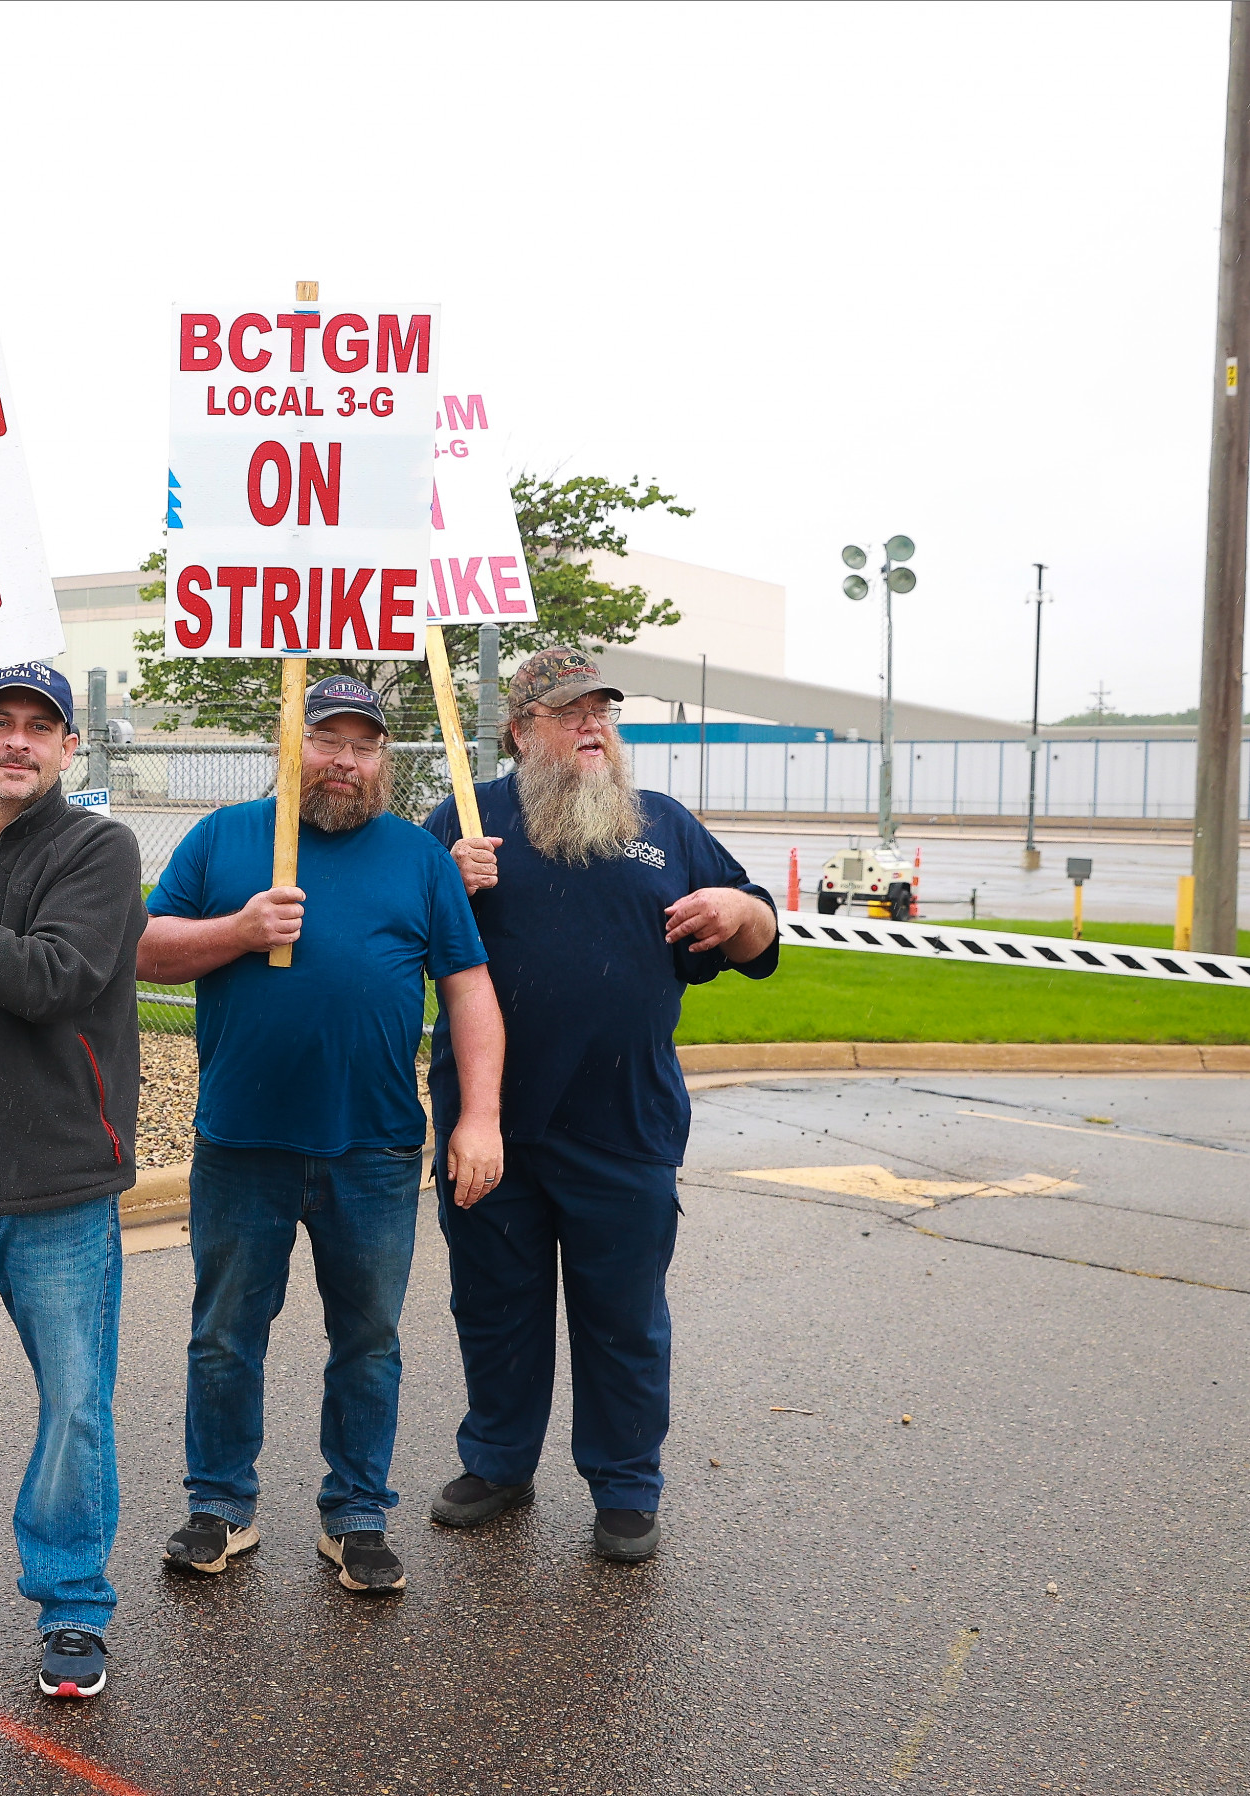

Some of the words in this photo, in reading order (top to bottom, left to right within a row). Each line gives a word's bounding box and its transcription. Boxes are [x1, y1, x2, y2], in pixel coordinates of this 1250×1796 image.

[180, 313, 431, 373] BCTGM
[207, 386, 324, 417] LOCAL
[336, 386, 394, 417] 3-G
[248, 441, 342, 527] ON
[427, 556, 528, 617] IKE
[175, 566, 418, 651] STRIKE
[0, 669, 31, 680] LOCAL
[69, 792, 106, 806] NOTICE
[624, 839, 664, 857] ConAgra
[638, 849, 665, 866] Foods
